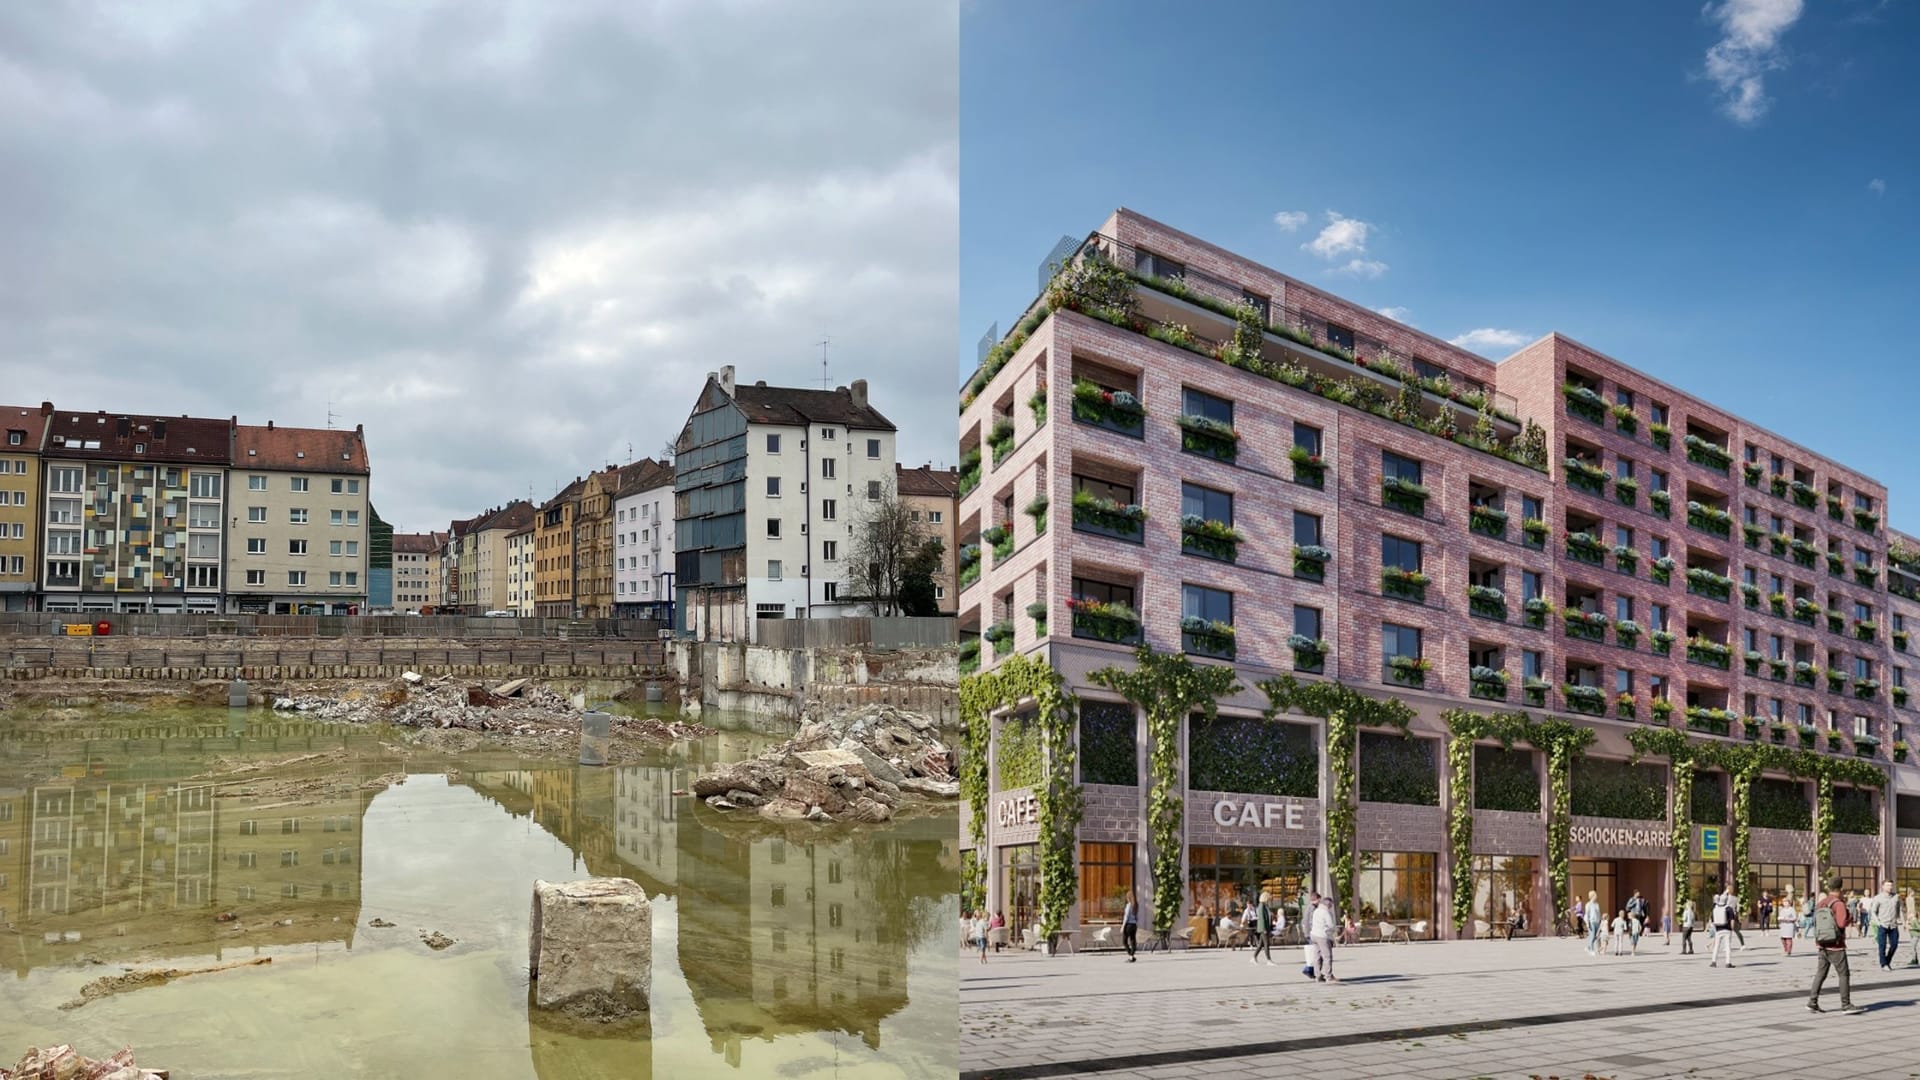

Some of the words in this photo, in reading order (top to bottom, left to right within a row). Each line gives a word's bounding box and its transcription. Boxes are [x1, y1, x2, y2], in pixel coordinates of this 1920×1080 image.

[998, 795, 1037, 827] CAFE
[1213, 800, 1304, 830] CAFE
[1569, 826, 1673, 847] SCHOCKEN-CARRE
[1703, 829, 1717, 850] E
